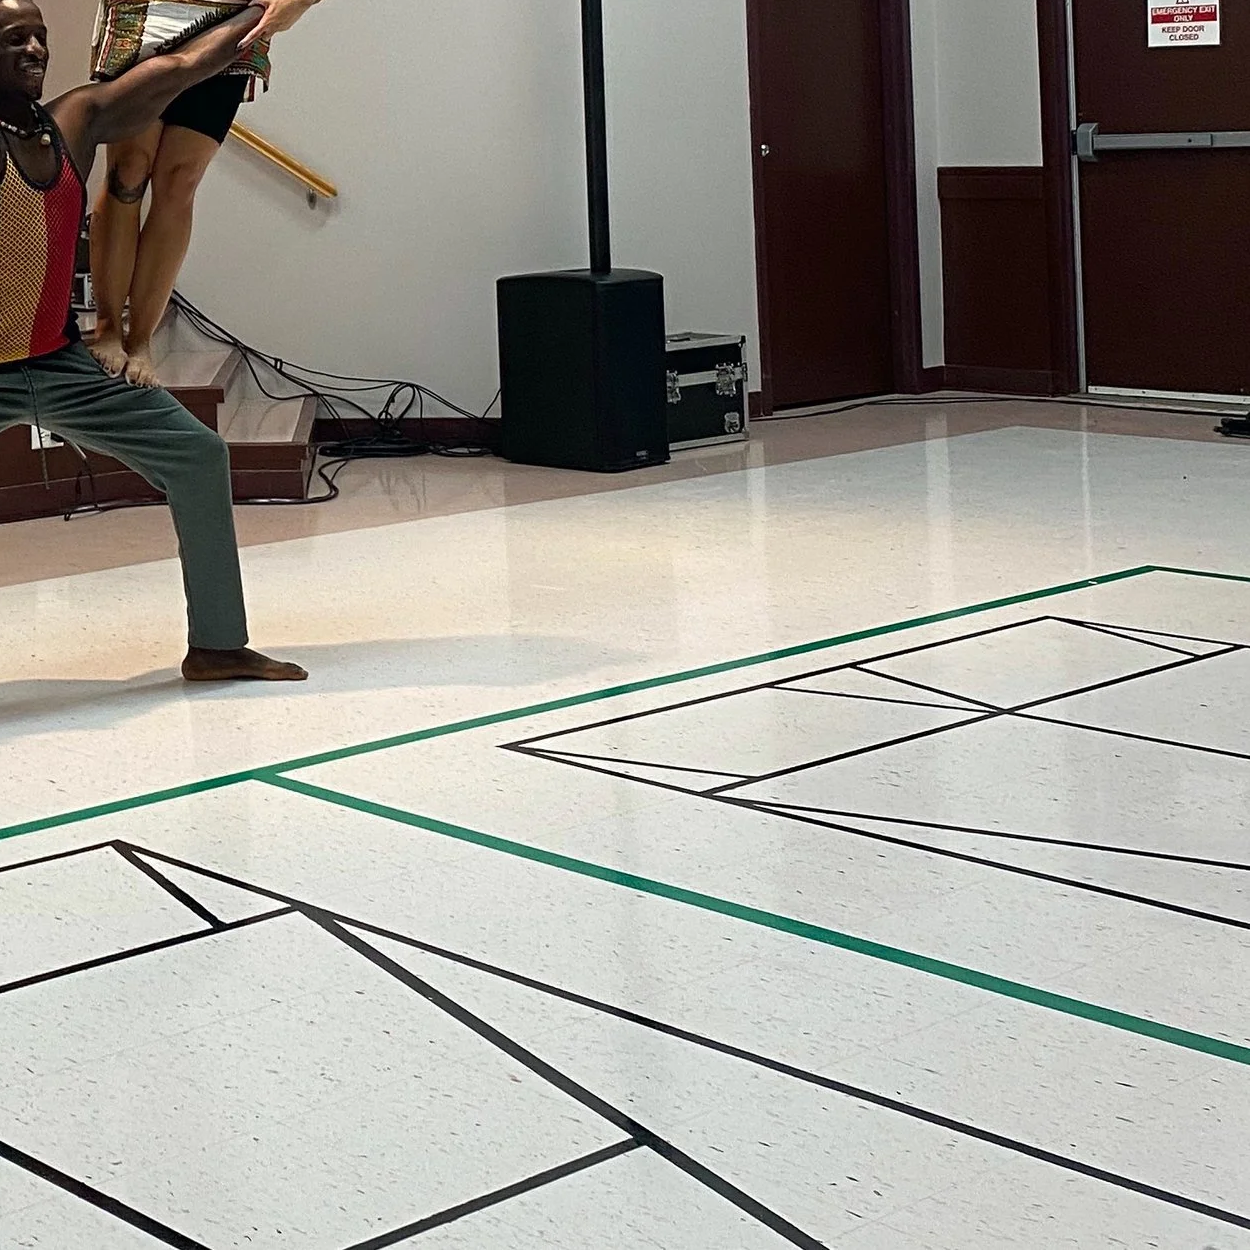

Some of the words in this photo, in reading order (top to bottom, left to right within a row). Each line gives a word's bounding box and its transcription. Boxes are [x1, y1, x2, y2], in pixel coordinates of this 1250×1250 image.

[1152, 6, 1198, 15] EMERGENCY
[1199, 5, 1215, 13] EXIT
[1169, 33, 1199, 41] CLOSED
